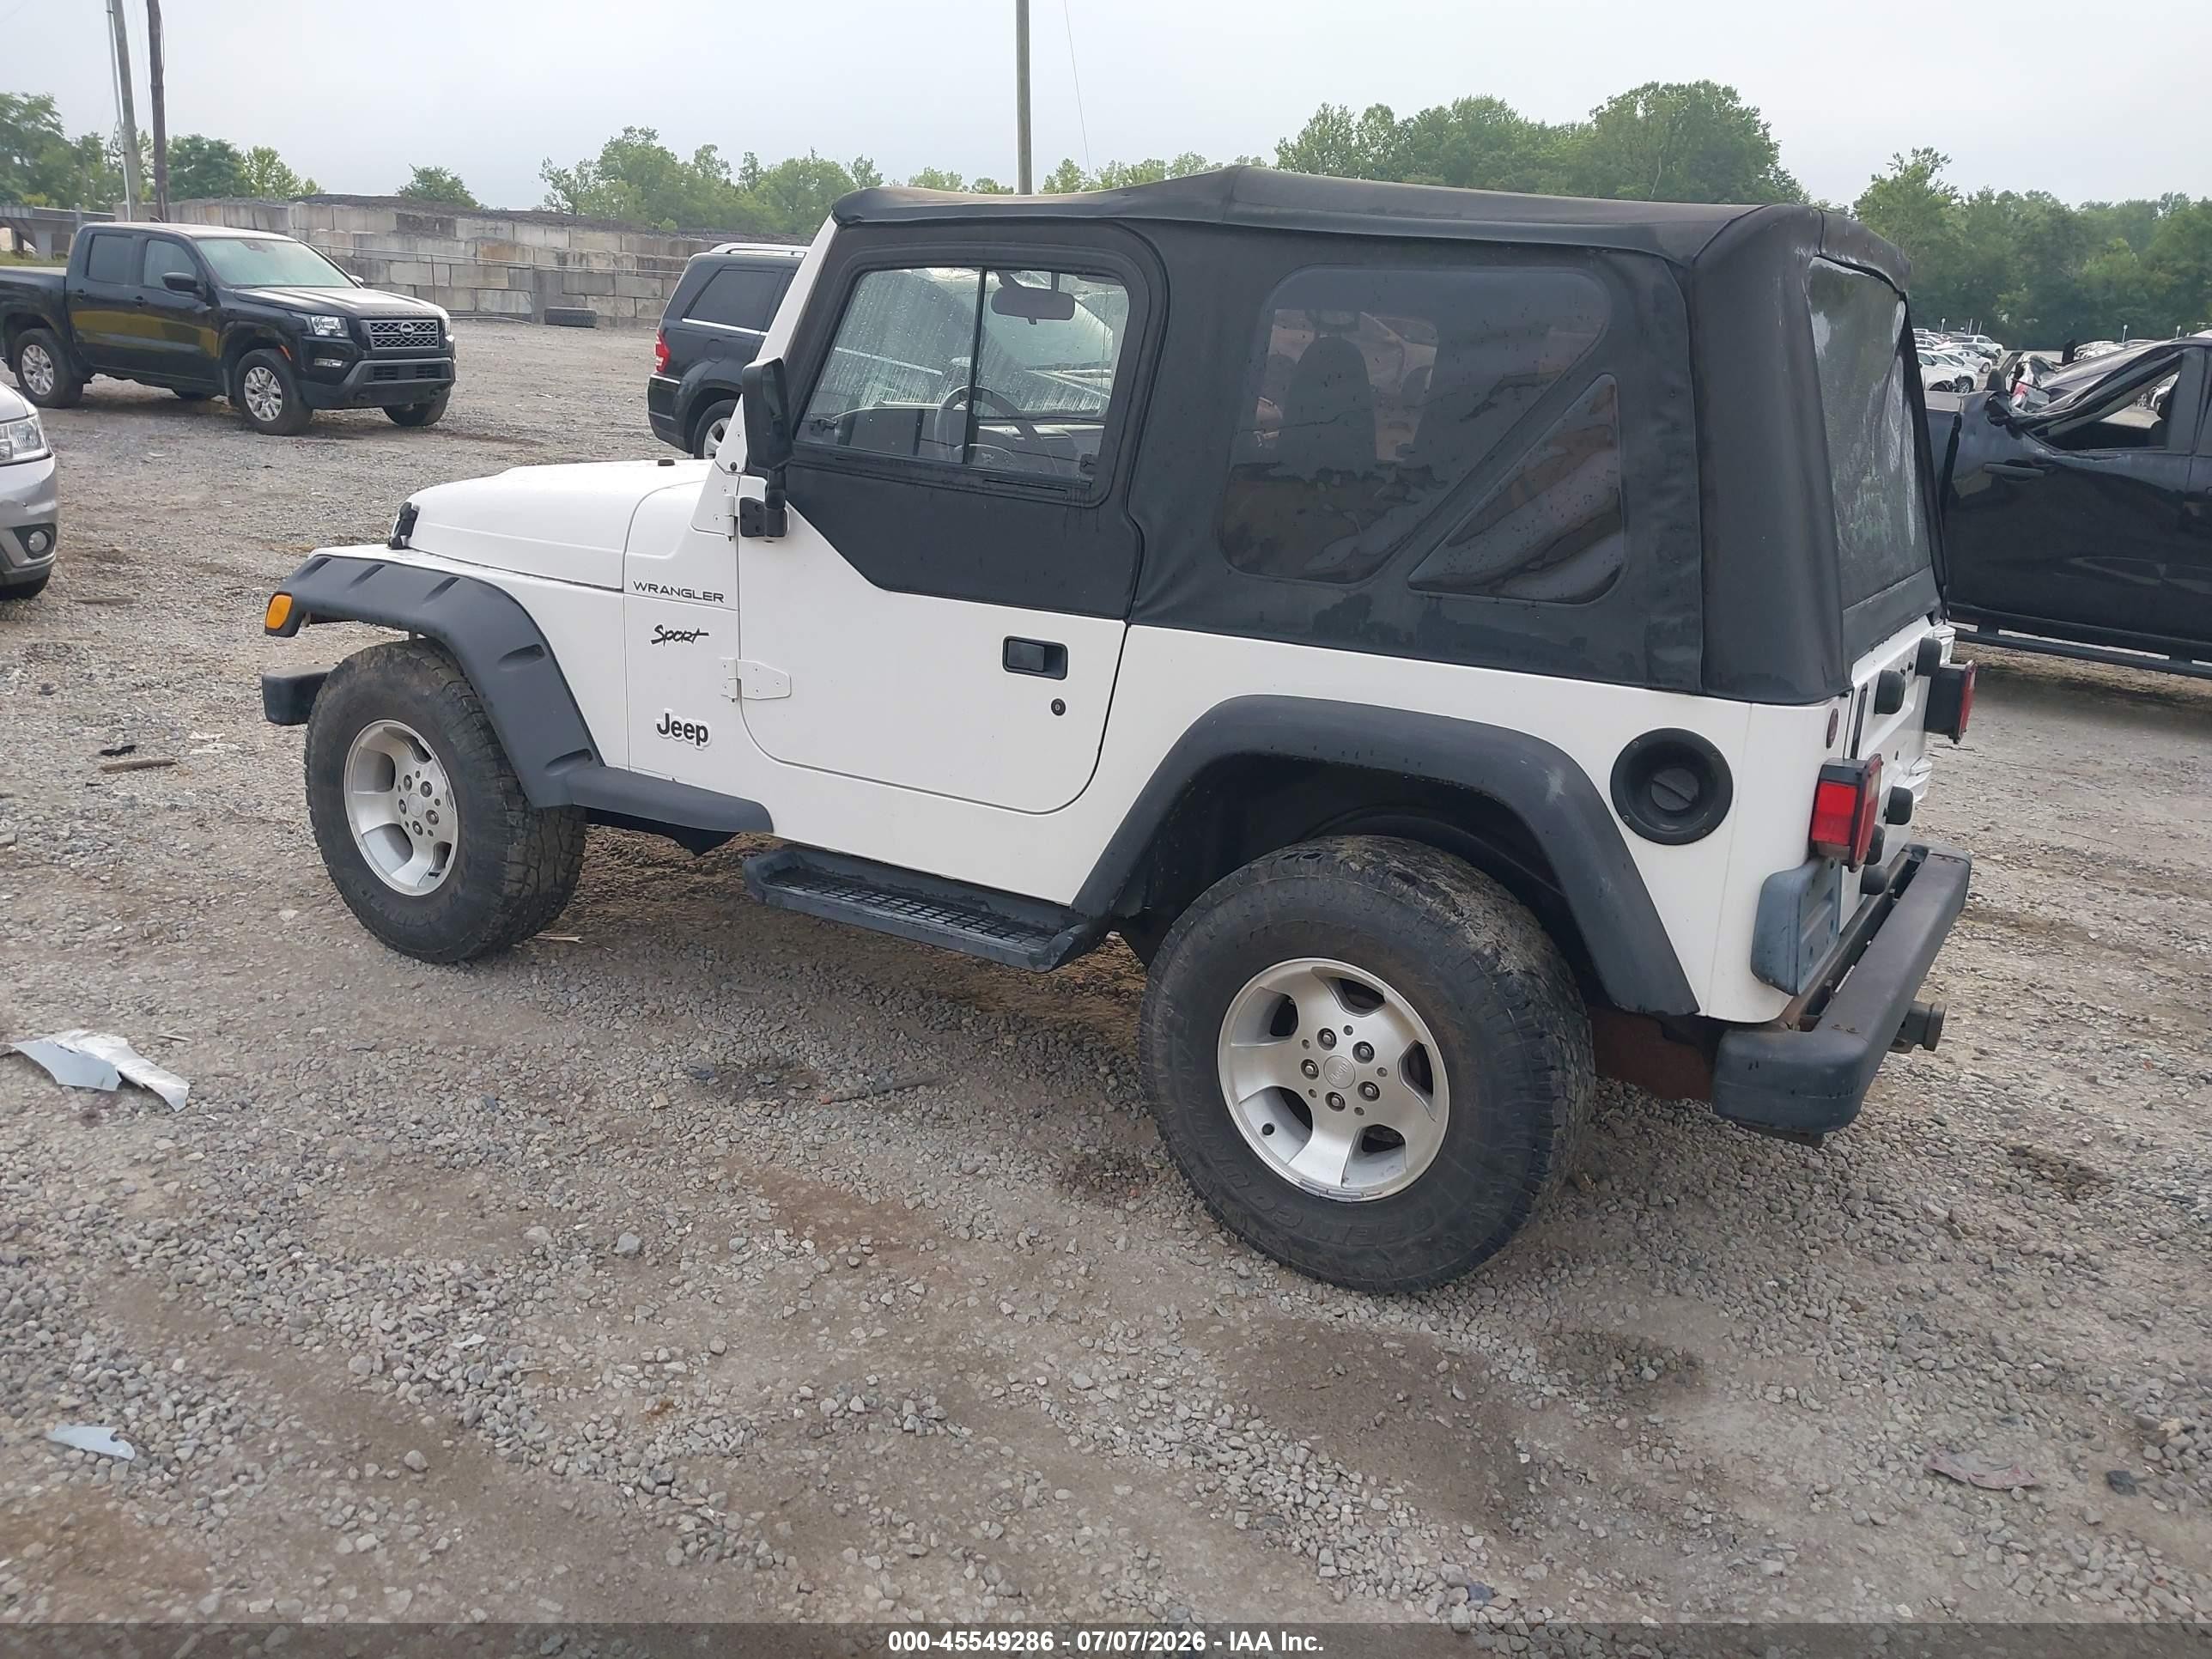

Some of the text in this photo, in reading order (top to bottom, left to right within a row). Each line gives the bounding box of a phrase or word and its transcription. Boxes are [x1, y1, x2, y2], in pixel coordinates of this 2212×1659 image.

[633, 580, 725, 603] WRANGLER
[650, 624, 709, 647] Sport
[656, 712, 709, 746] Jeep
